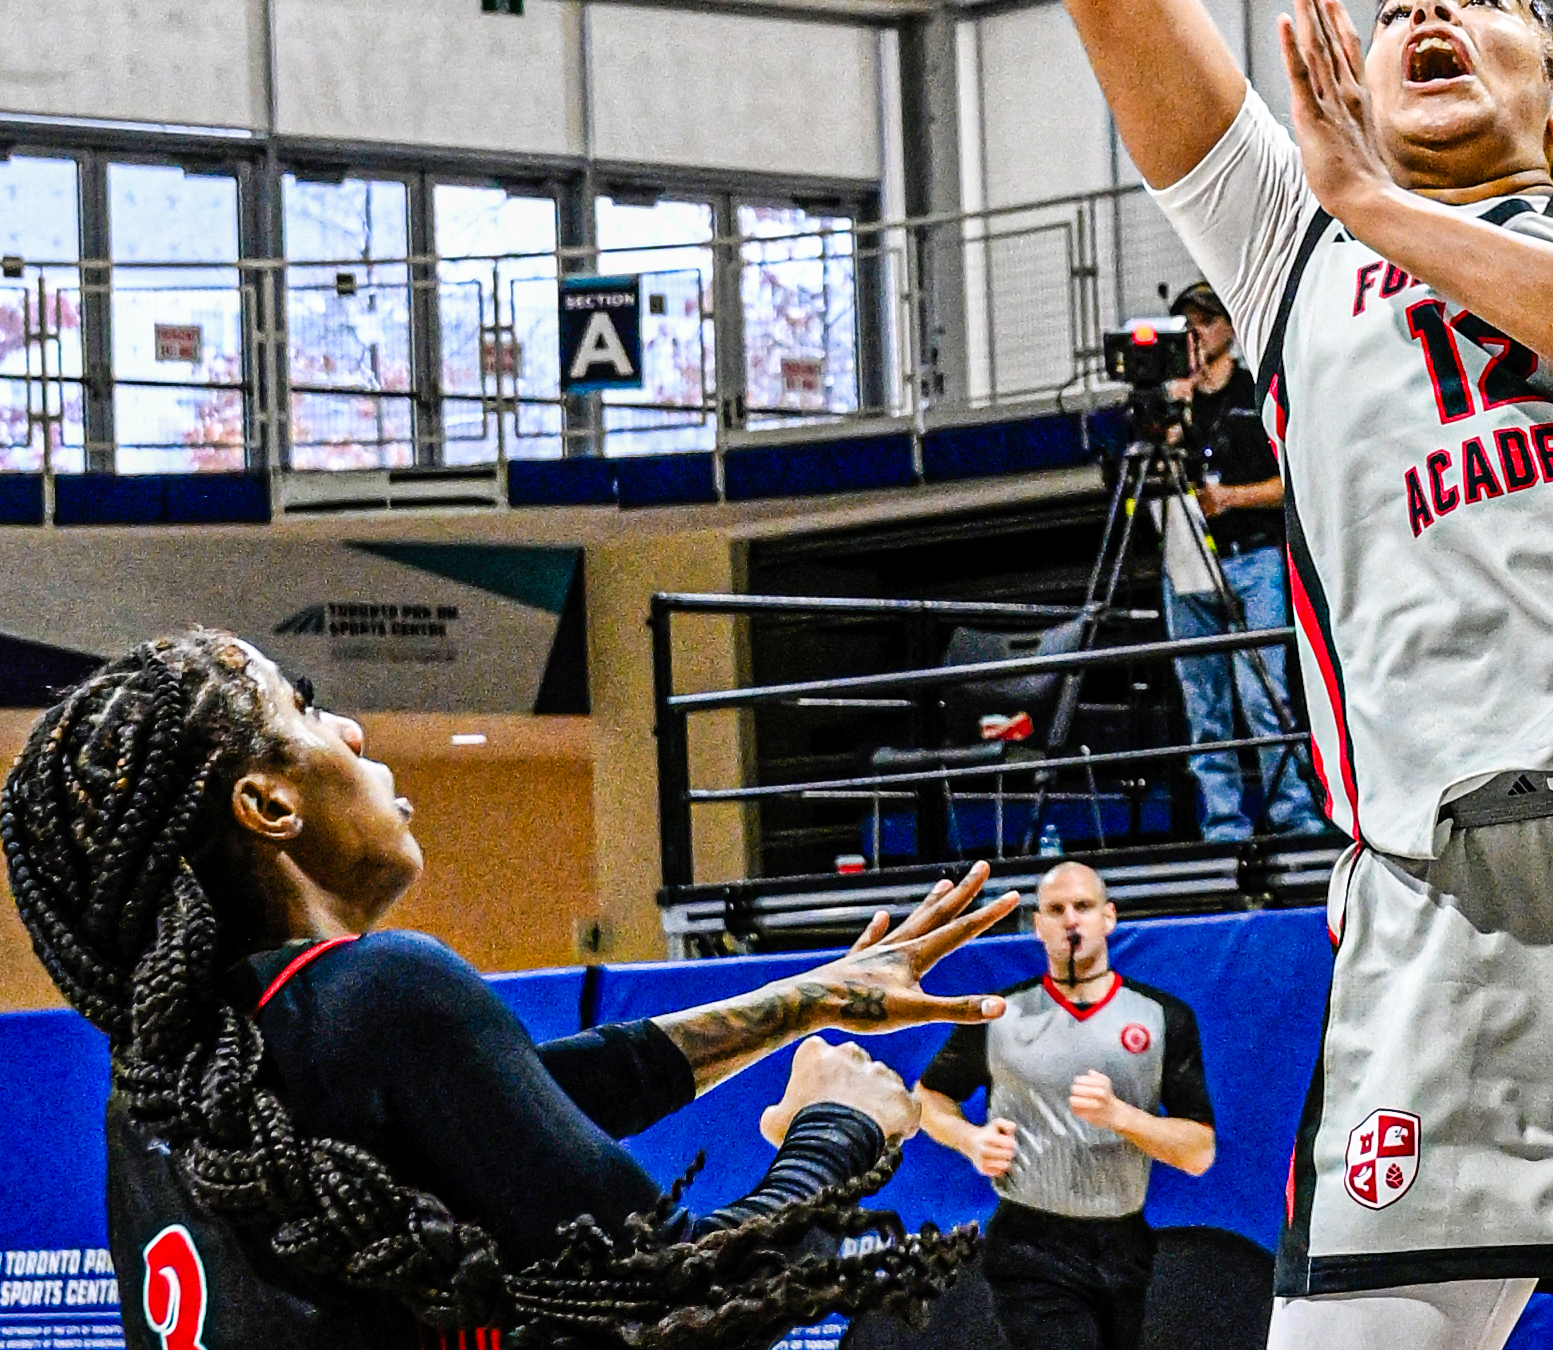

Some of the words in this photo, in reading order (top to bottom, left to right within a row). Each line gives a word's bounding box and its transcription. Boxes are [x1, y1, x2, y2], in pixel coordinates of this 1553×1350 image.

[565, 293, 635, 309] SECTION
[569, 311, 634, 379] A
[1405, 298, 1546, 425] 12
[5, 1250, 81, 1276] TORONTO
[0, 1280, 63, 1307] SPORTS
[65, 1279, 120, 1306] CENTR
